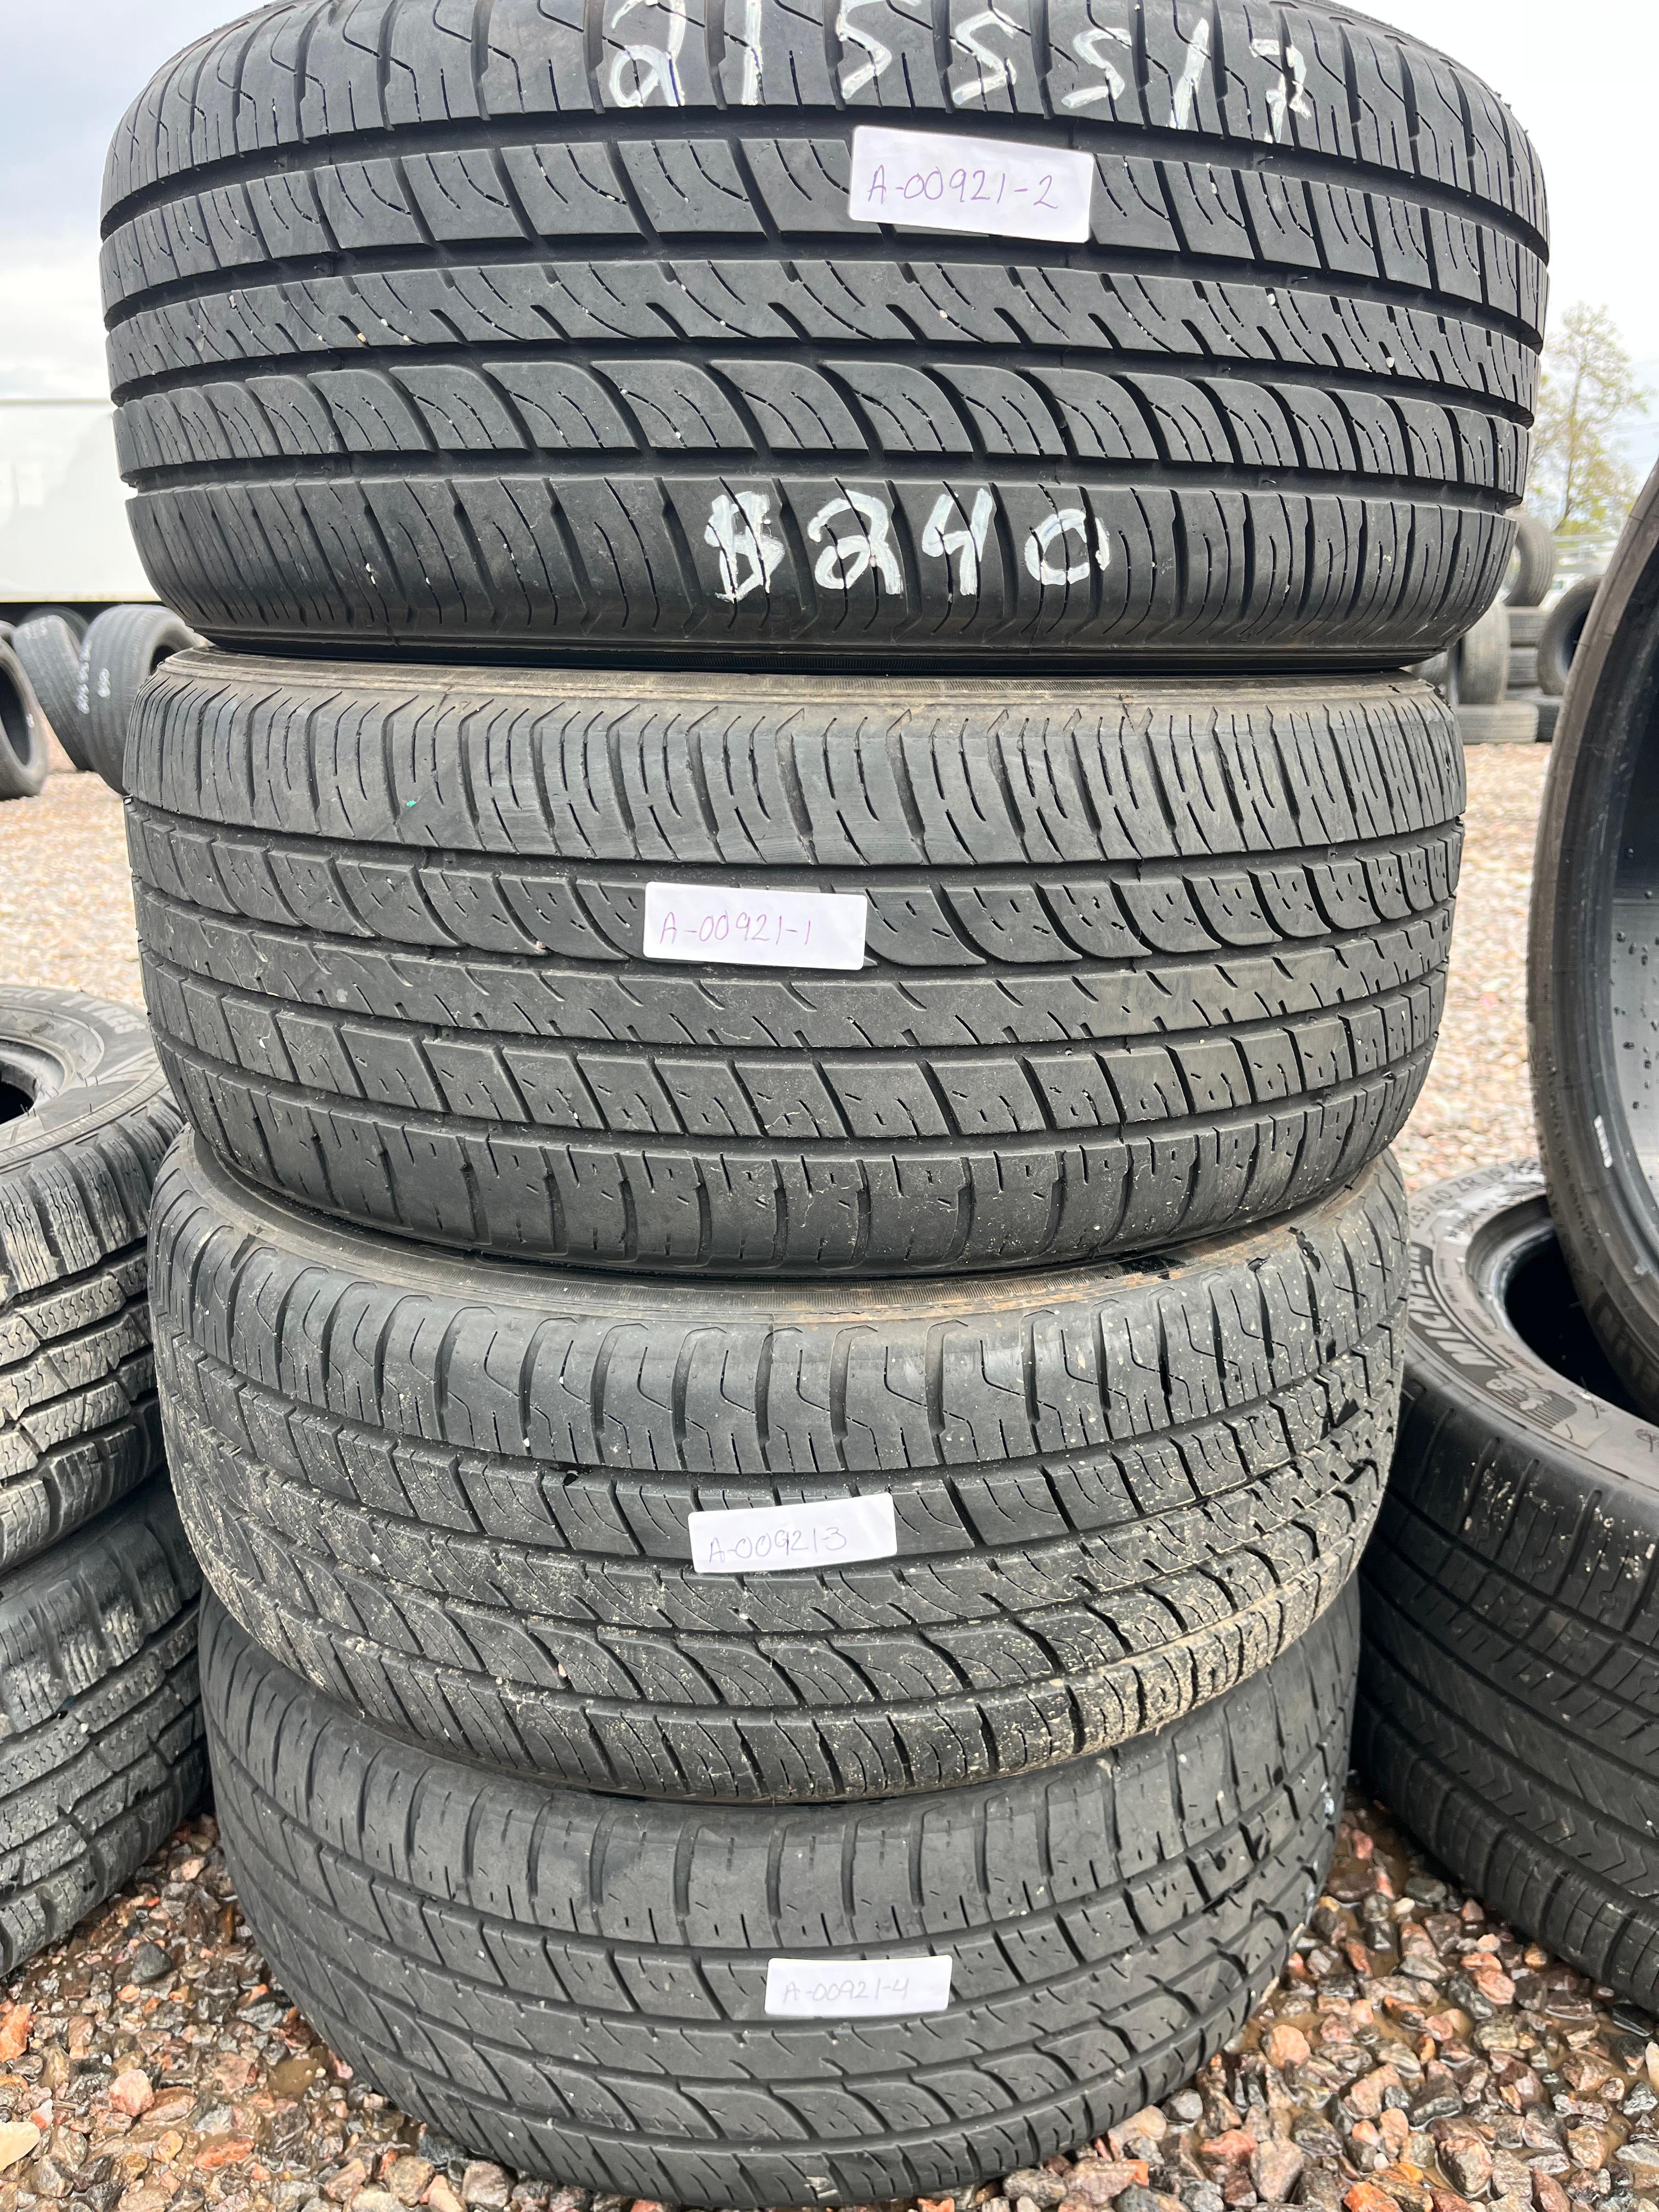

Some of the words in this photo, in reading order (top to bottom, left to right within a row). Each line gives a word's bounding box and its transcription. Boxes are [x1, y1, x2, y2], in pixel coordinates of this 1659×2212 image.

[867, 164, 1059, 209] A-00921-2
[659, 910, 811, 946] A-00921-1
[782, 1977, 910, 2004] A-00921-4
